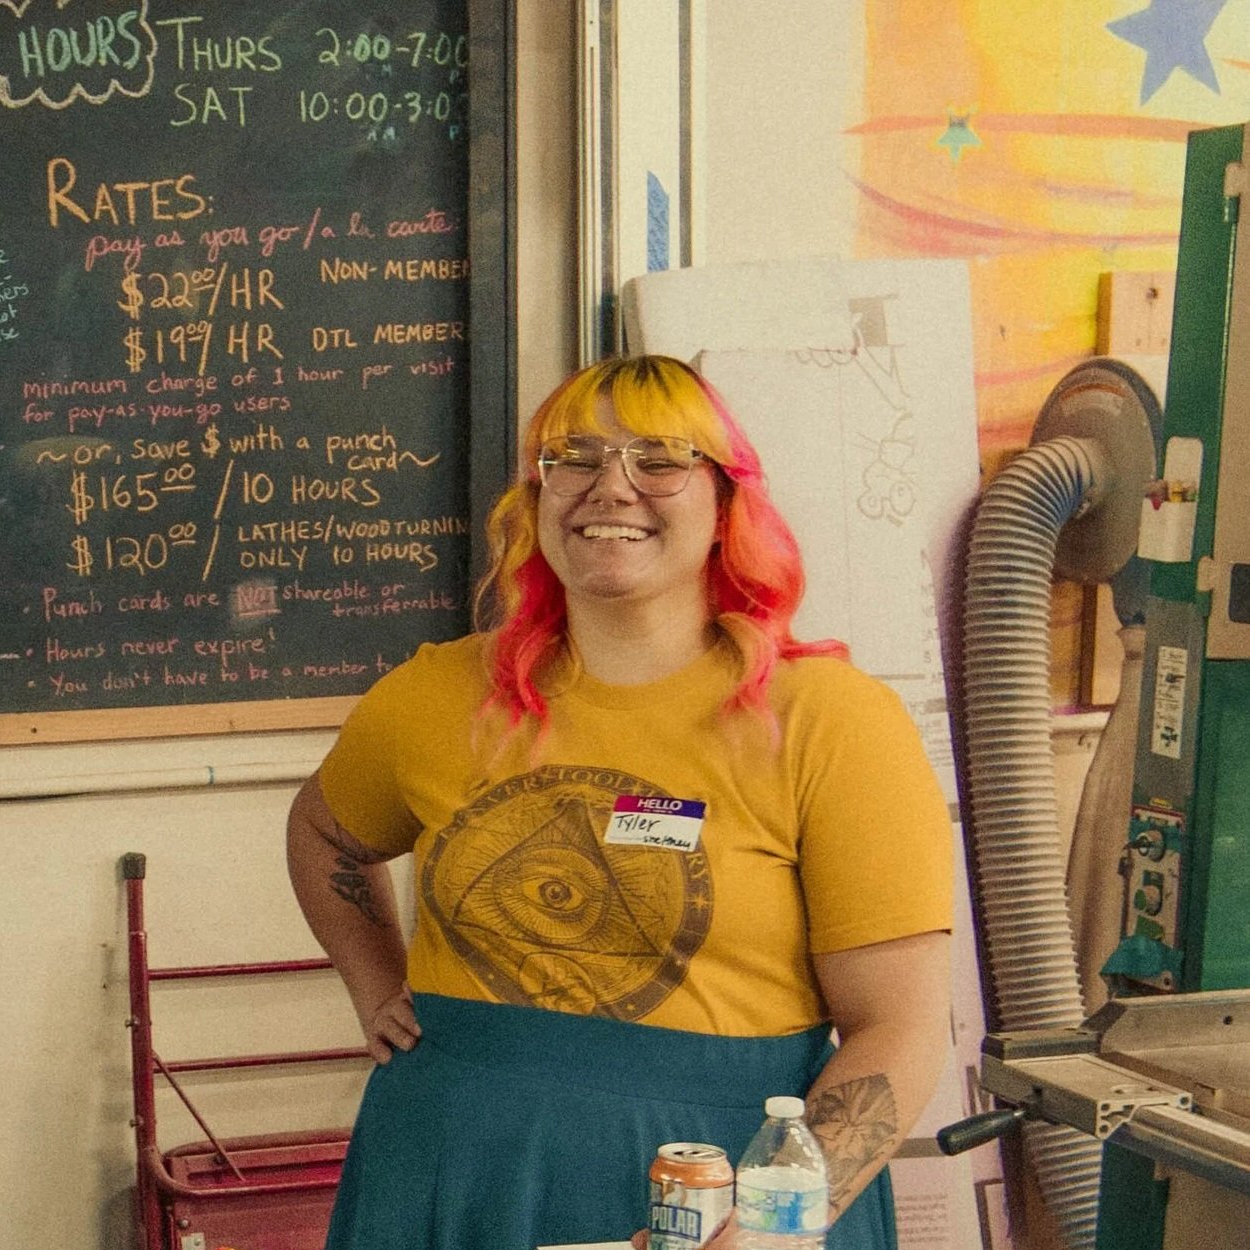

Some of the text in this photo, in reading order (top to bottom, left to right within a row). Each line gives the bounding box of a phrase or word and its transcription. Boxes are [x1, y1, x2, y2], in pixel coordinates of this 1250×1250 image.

[18, 12, 140, 78] HOURS
[156, 16, 282, 72] THURS
[170, 84, 467, 127] SAT 10:00-3:0
[49, 158, 214, 227] RATES:
[84, 230, 146, 272] pay
[155, 226, 184, 249] as
[200, 221, 249, 261] you
[312, 327, 358, 352] DTL
[22, 356, 455, 399] minimum charge of 1 hour per visit
[22, 395, 291, 433] for pay-as-you-go users
[202, 422, 220, 459] $
[229, 422, 285, 454] with
[296, 436, 310, 450] a
[325, 428, 397, 465] punch
[242, 471, 274, 505] 10
[291, 476, 382, 507] HOURS
[239, 542, 439, 573] ONLY 10 HOURS
[41, 586, 104, 622] Punch
[117, 589, 171, 613] cards
[183, 592, 220, 608] are
[381, 582, 406, 597] or
[46, 637, 107, 663] Hours
[121, 635, 180, 656] never
[49, 671, 88, 698] You
[163, 665, 207, 686] have
[221, 667, 239, 682] to
[249, 662, 269, 680] be
[282, 666, 293, 678] a
[303, 658, 368, 678] member
[614, 813, 661, 832] Tyler
[636, 798, 683, 811] HELLO
[652, 1206, 699, 1239] POLAR
